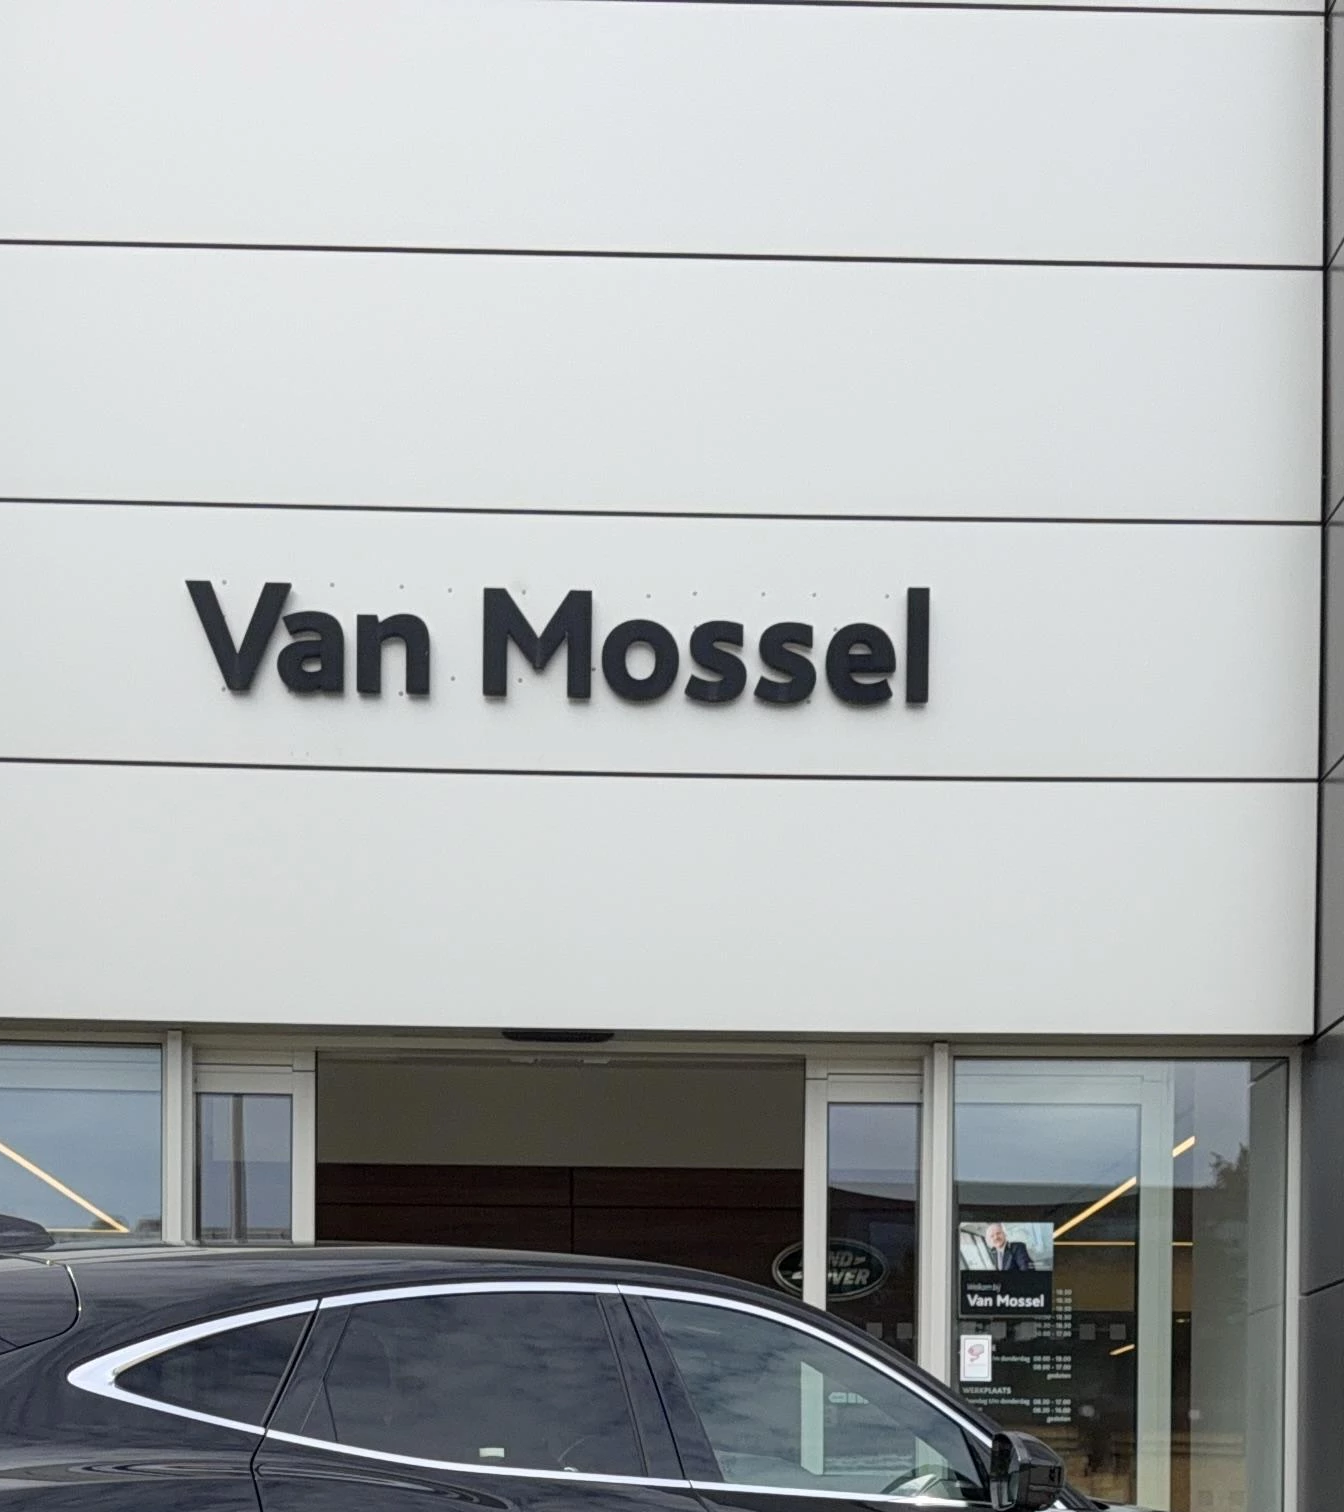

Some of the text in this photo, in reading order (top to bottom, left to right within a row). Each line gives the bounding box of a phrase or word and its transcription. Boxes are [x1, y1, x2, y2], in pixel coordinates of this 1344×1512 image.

[184, 579, 931, 703] Van Mossel
[967, 1293, 993, 1307] Van
[997, 1293, 1045, 1307] Mossel
